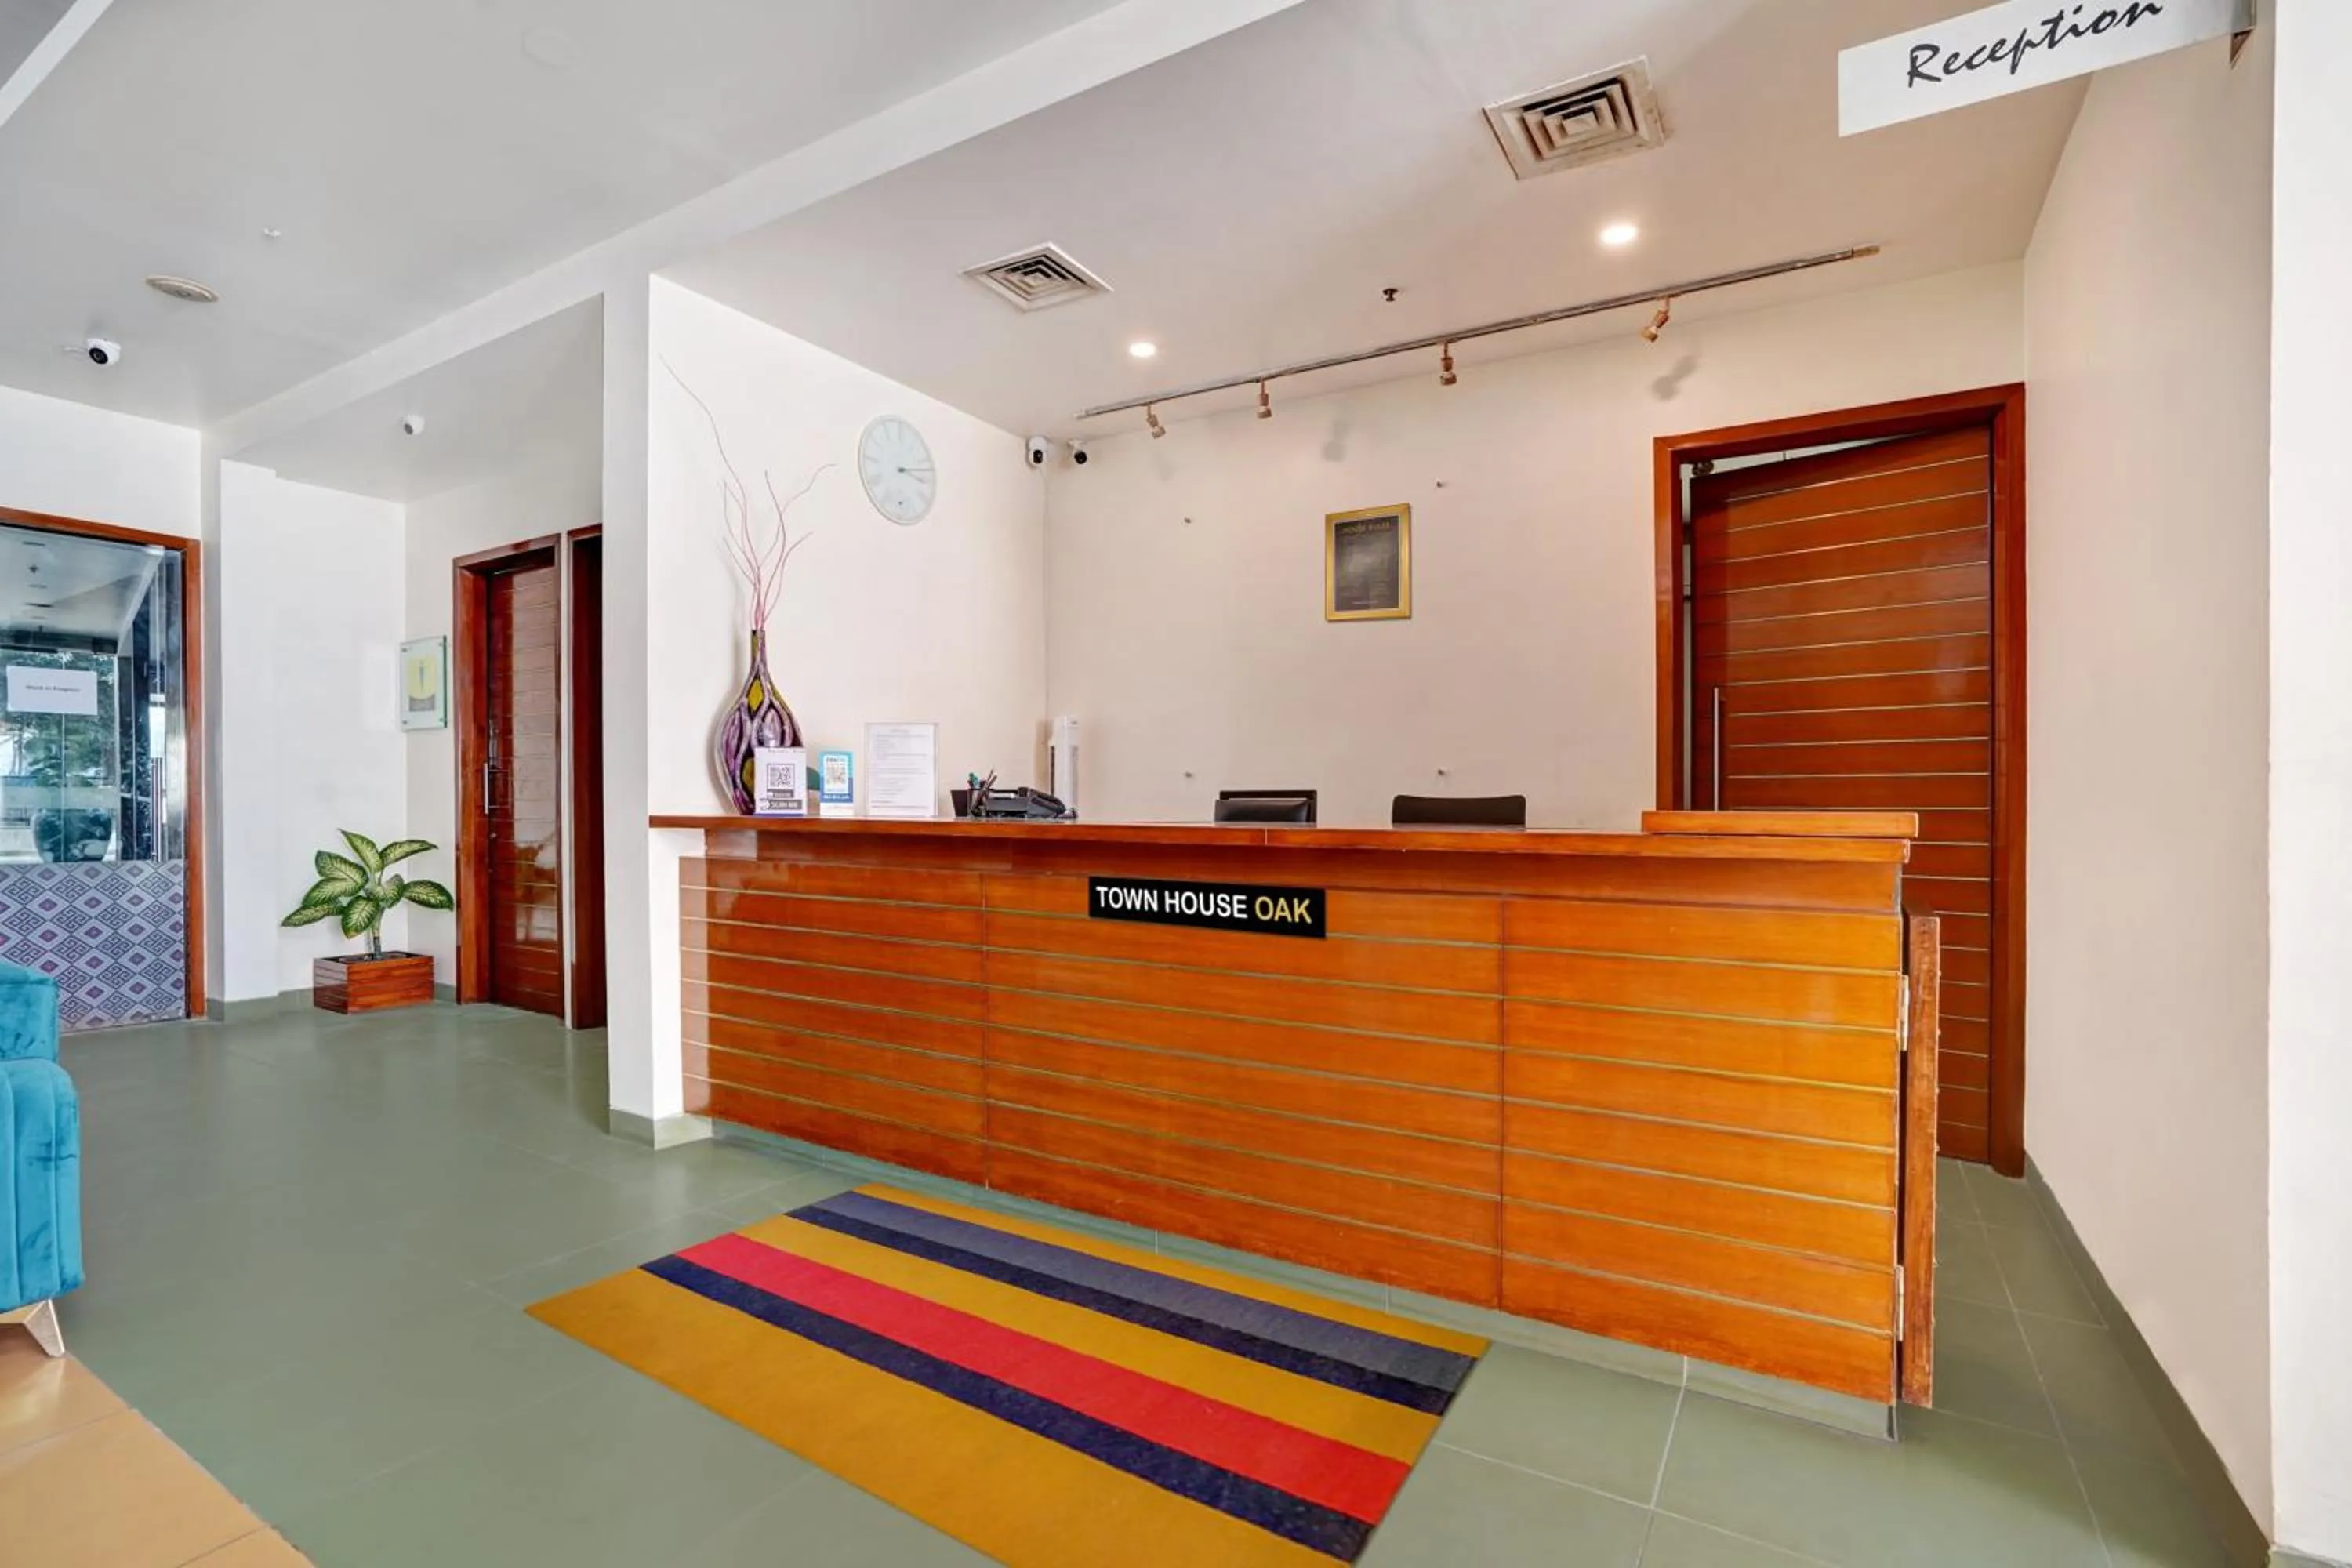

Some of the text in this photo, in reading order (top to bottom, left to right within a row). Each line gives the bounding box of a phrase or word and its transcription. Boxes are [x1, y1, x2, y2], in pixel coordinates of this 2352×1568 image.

[1907, 1, 2163, 89] Reception
[1096, 886, 1312, 924] TOWN HOUSE OAK
